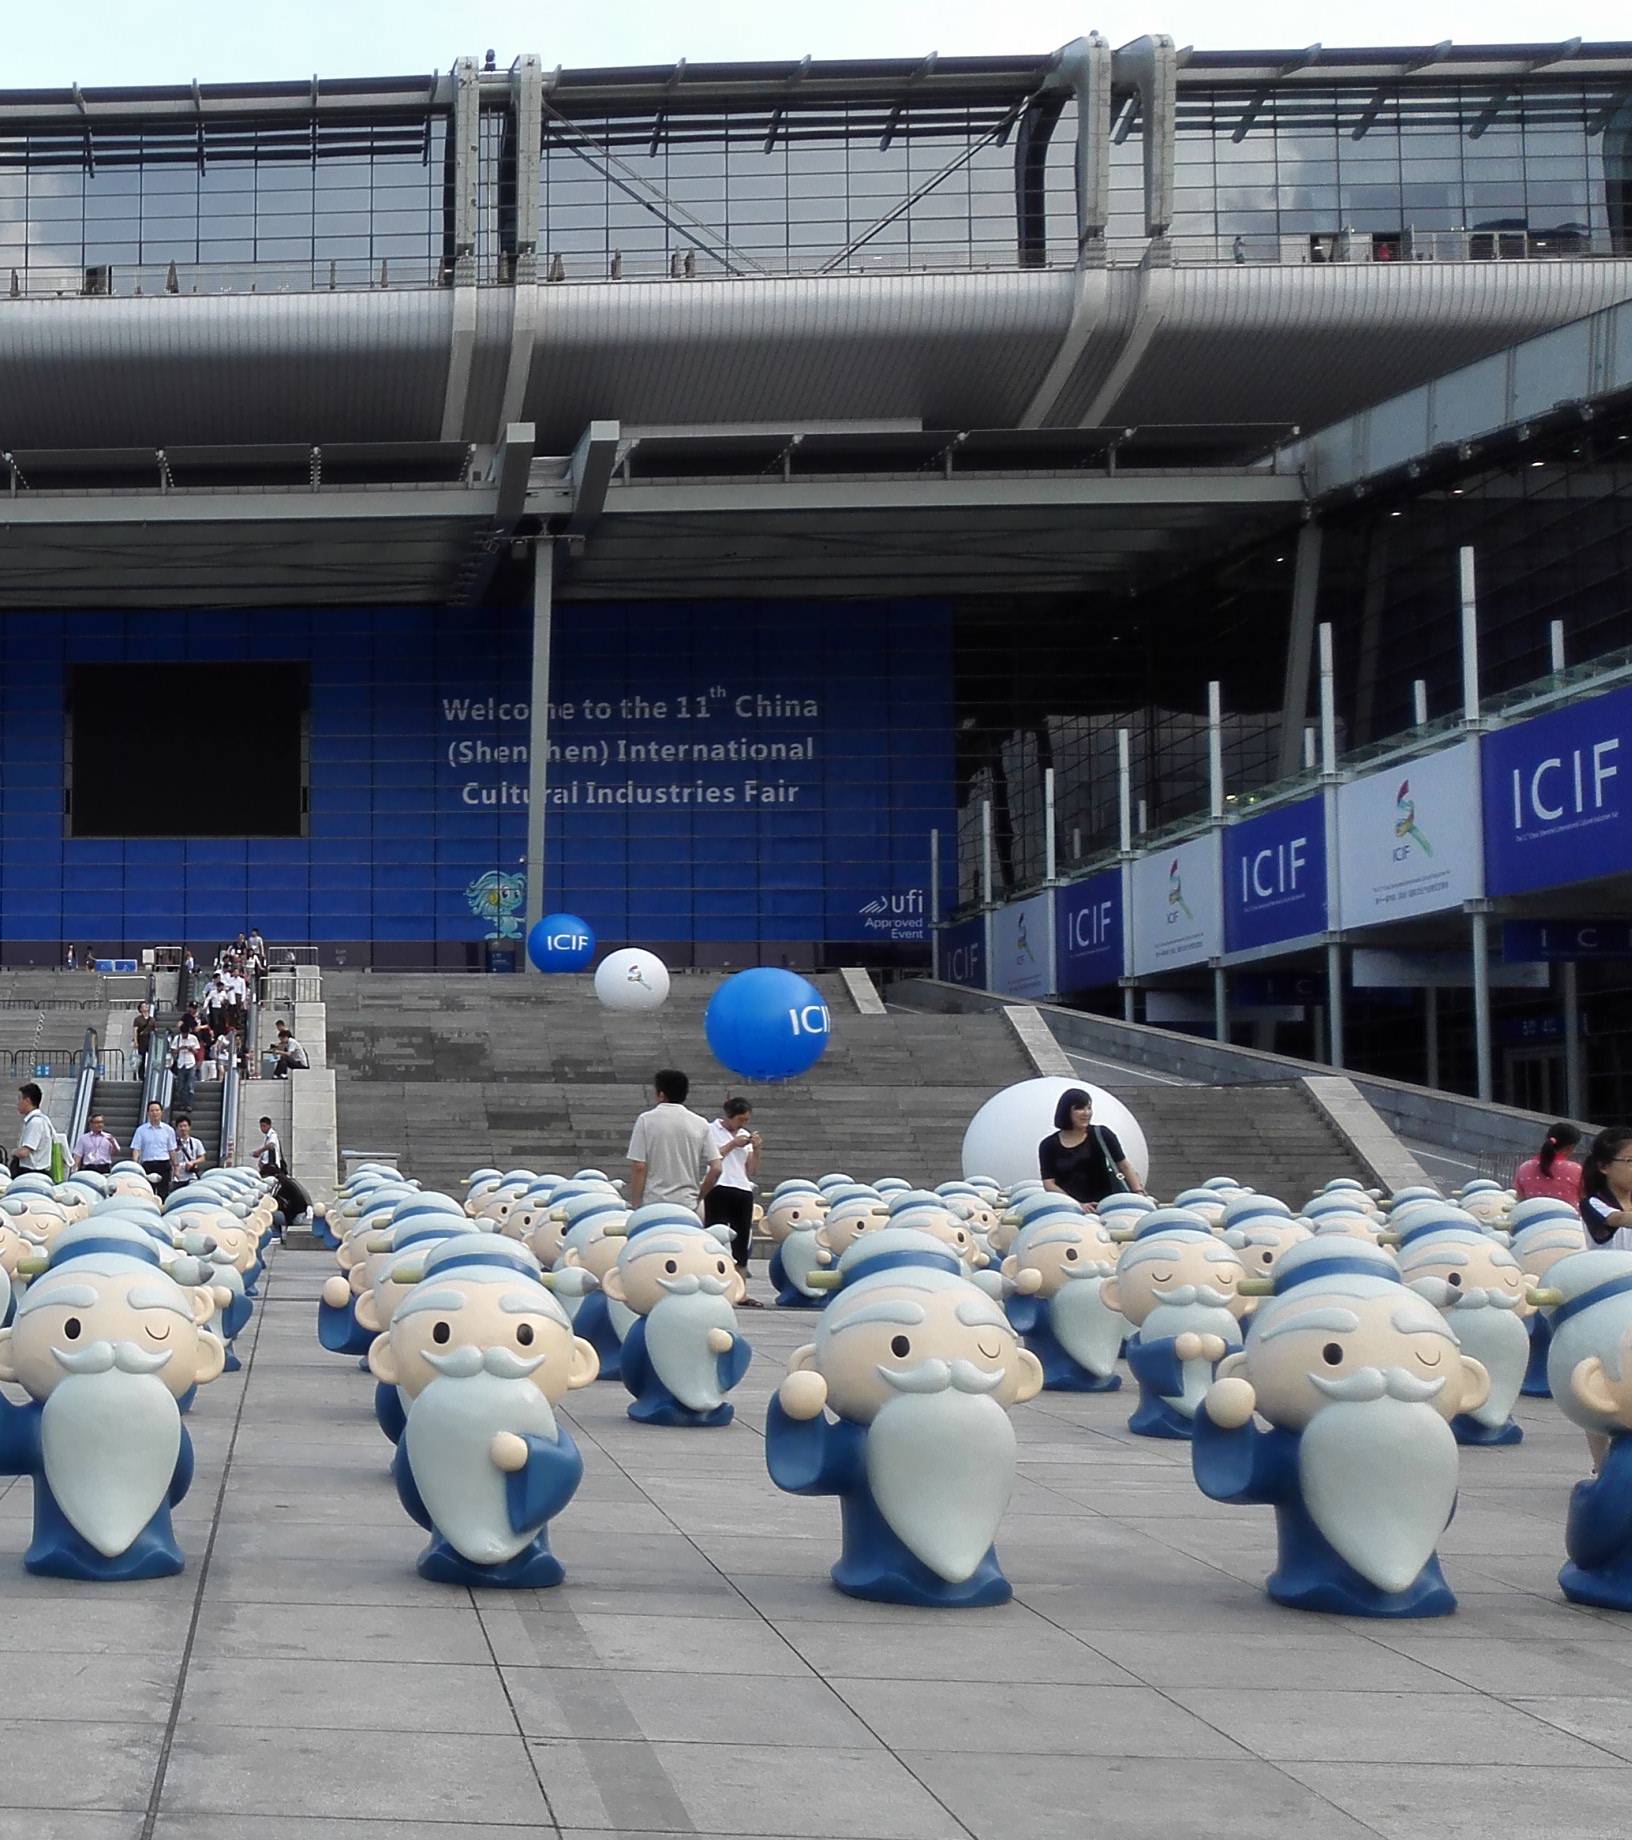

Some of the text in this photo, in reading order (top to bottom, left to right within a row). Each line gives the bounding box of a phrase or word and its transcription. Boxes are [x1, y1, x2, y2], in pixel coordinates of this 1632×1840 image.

[582, 699, 612, 720] to
[619, 695, 668, 719] the
[676, 685, 727, 719] 11th
[734, 693, 818, 718] China
[447, 736, 814, 768] (Shenhen) International
[585, 779, 736, 804] Industries
[743, 778, 800, 803] Fair
[1513, 738, 1619, 829] ICIF
[1242, 837, 1307, 903] ICIF
[891, 889, 923, 913] ufi
[864, 917, 923, 930] Approved
[891, 928, 923, 939] Event
[1068, 900, 1112, 951] ICIF
[547, 934, 589, 951] ICIF
[947, 943, 979, 982] ICIF
[789, 1005, 831, 1036] ICI
